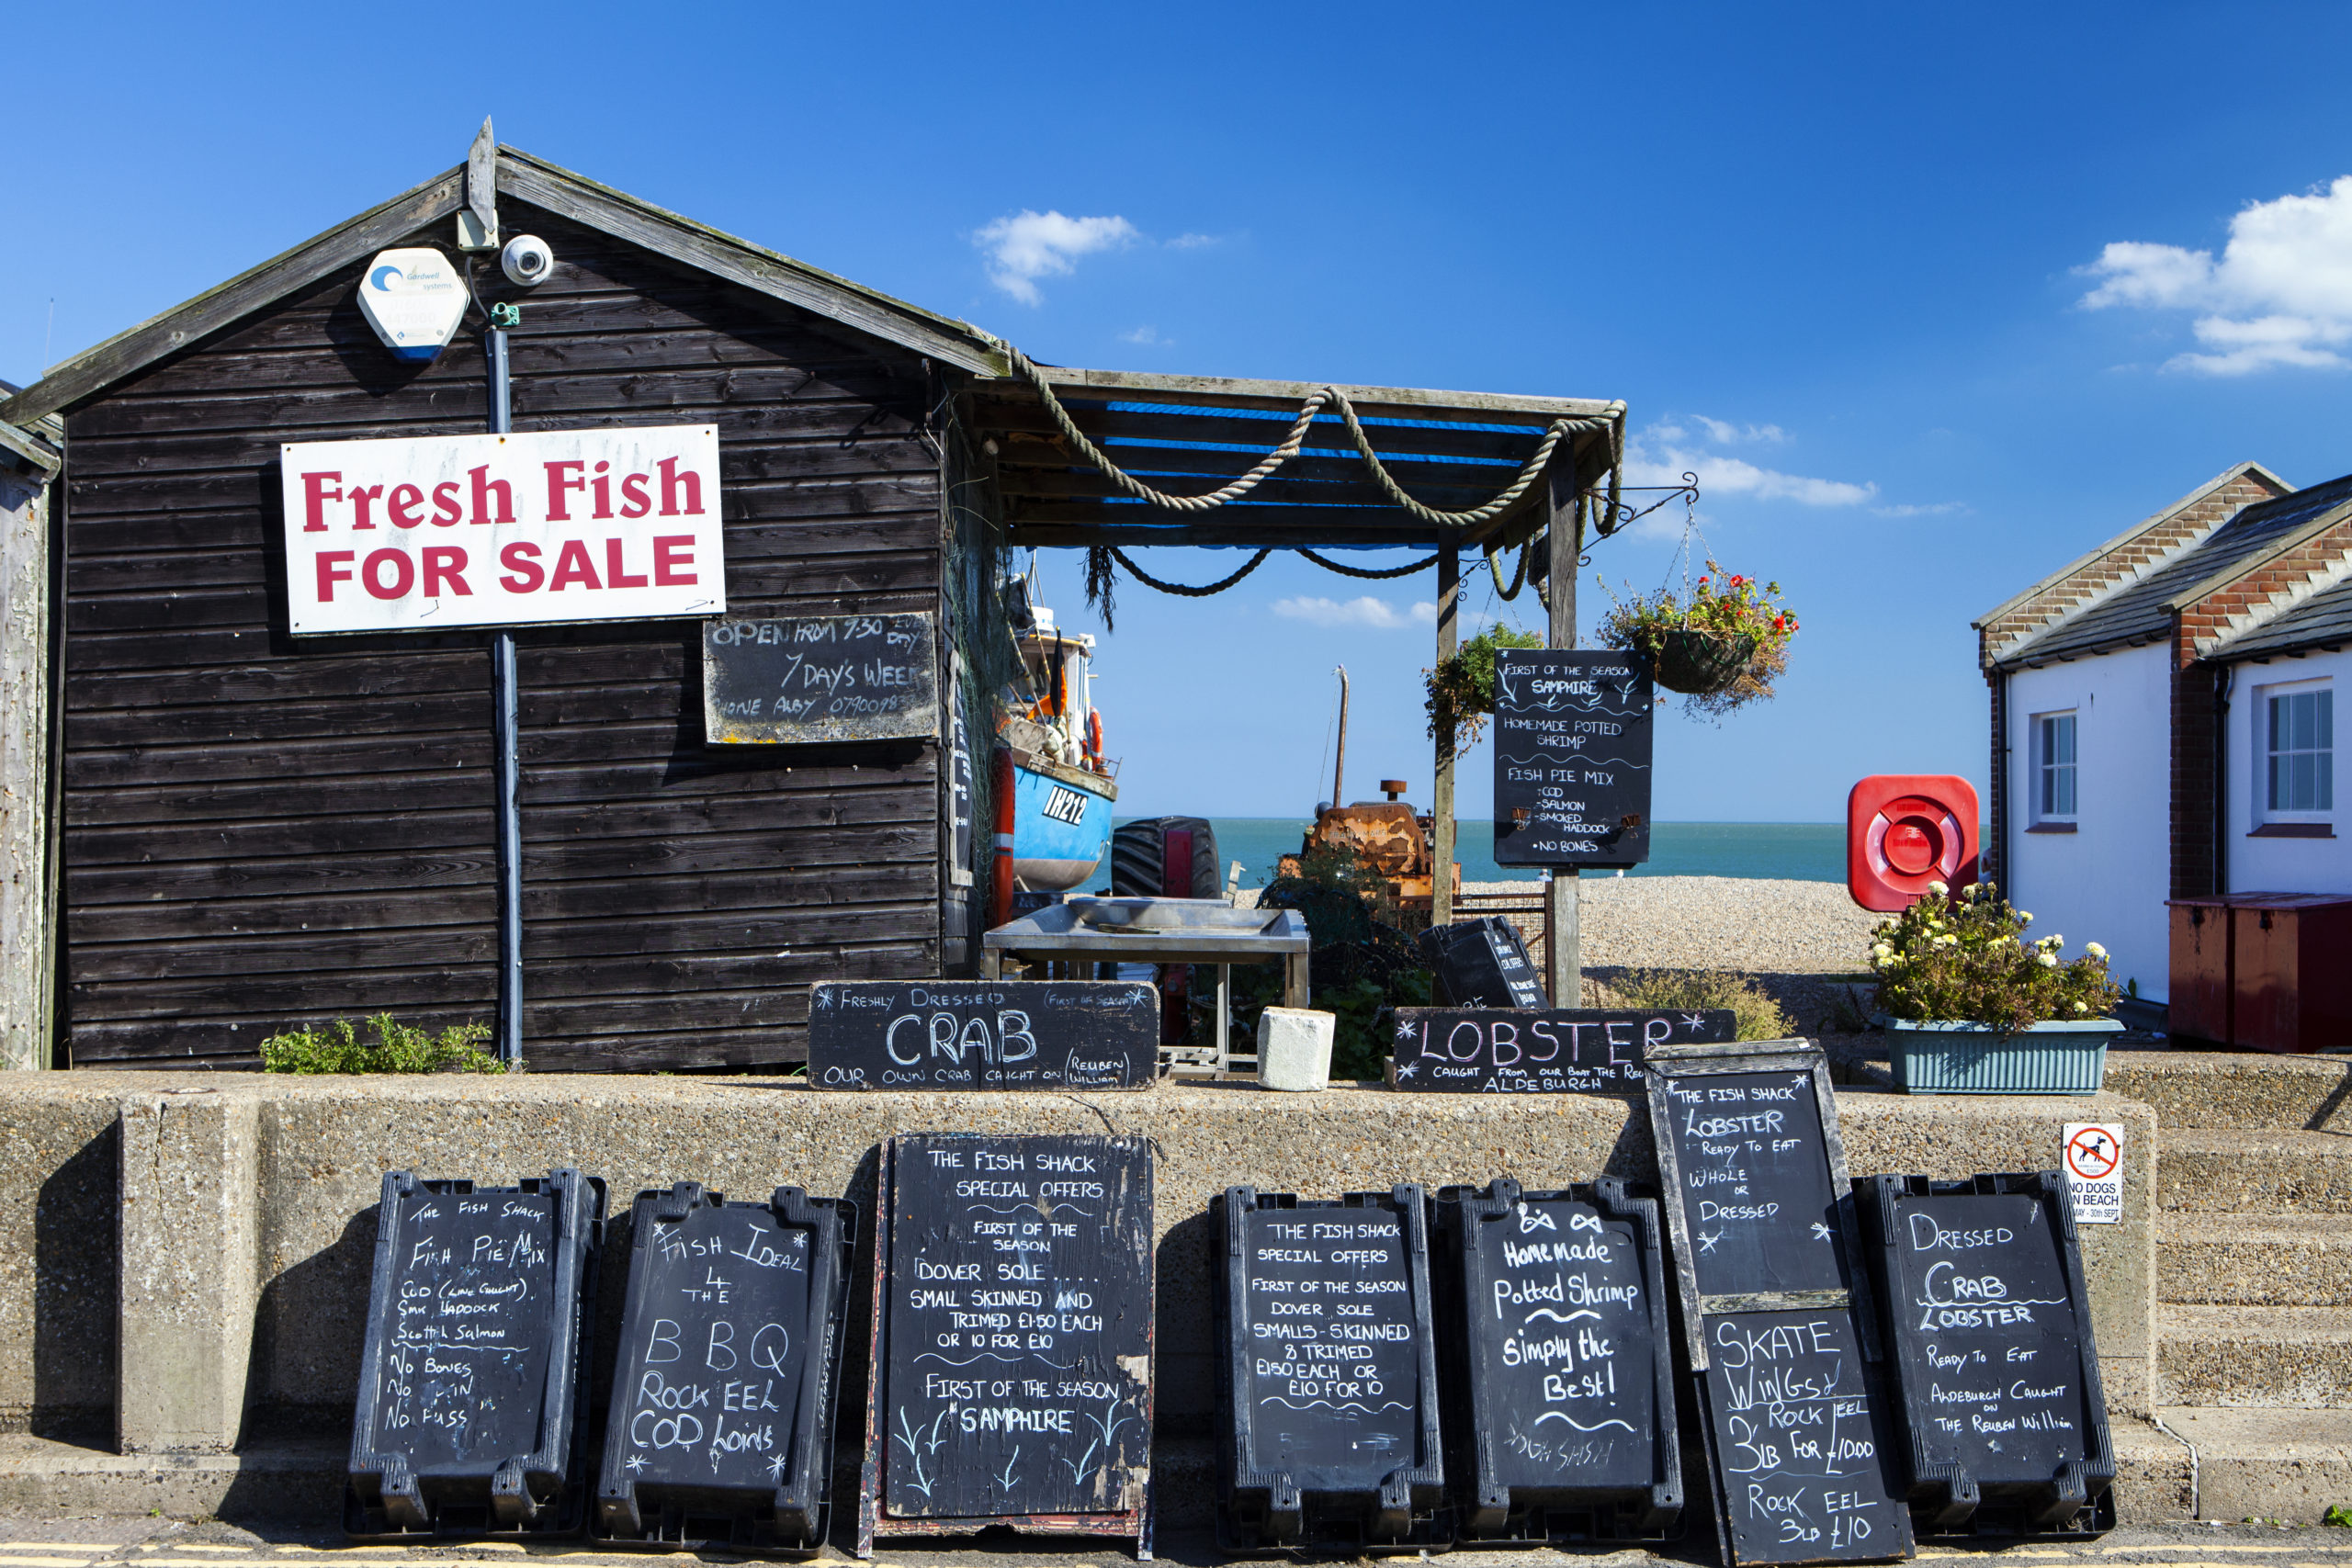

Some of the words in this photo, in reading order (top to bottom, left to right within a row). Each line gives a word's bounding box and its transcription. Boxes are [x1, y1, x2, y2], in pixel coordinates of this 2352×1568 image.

[407, 272, 440, 280] Gardwell
[300, 463, 516, 533] Fresh
[543, 455, 706, 522] Fish
[315, 545, 473, 603] FOR
[498, 535, 698, 593] SALE
[713, 623, 789, 646] OPEN
[794, 621, 835, 643] FROM
[781, 652, 803, 688] 7
[1504, 663, 1538, 676] FIRST
[1544, 664, 1557, 675] OF
[1564, 666, 1581, 676] THE
[1590, 665, 1633, 676] SEASON
[1531, 680, 1598, 695] SAMPHIRE
[774, 695, 816, 720] ALBY
[1504, 717, 1567, 733] HOMEMADE
[1575, 720, 1622, 736] POTTED
[1536, 735, 1587, 750] SHRIMP
[1508, 768, 1543, 781] FISH
[1551, 769, 1576, 782] PIE
[1585, 771, 1614, 785] MIX
[1043, 786, 1088, 825] IH212
[1563, 823, 1611, 835] HADDOCK
[1539, 840, 1557, 852] NO
[1560, 840, 1599, 852] BONES
[841, 989, 896, 1011] FRESHLY
[910, 987, 1005, 1007] DRESSED
[886, 1009, 1037, 1066] CRAB
[1420, 1017, 1672, 1066] LOBSTER
[824, 1066, 865, 1085] OUR
[882, 1069, 926, 1084] OWN
[934, 1068, 972, 1082] CRAB
[1042, 1070, 1061, 1079] ON
[1432, 1066, 1480, 1078] CAUGHT
[1498, 1067, 1528, 1078] FROM
[1539, 1066, 1562, 1077] OUR
[1567, 1066, 1590, 1077] BOAT
[1593, 1066, 1616, 1078] THE
[1482, 1077, 1602, 1093] ALDEBURGH
[1675, 1090, 1704, 1103] THE
[1709, 1088, 1746, 1102] FISH
[1751, 1088, 1797, 1101] SHACK
[1683, 1108, 1784, 1138] LOBSTER
[928, 1150, 965, 1168] THE
[975, 1151, 1024, 1172] FISH
[1036, 1154, 1097, 1173] SHACK
[1702, 1141, 1740, 1166] READY
[1746, 1140, 1762, 1152] TO
[1772, 1139, 1802, 1152] EAT
[1690, 1168, 1748, 1188] WHOLE
[2070, 1182, 2084, 1193] NO
[2086, 1182, 2117, 1194] DOGS
[956, 1180, 1030, 1198] SPECIAL
[1040, 1181, 1103, 1199] OFFERS
[1735, 1186, 1749, 1195] OR
[2083, 1194, 2119, 1206] BEACH
[410, 1202, 441, 1223] THE
[459, 1201, 489, 1213] FISH
[501, 1201, 545, 1223] SHACK
[1700, 1201, 1780, 1221] DRESSED
[2090, 1208, 2103, 1218] 30th
[2104, 1208, 2119, 1218] SEPT
[974, 1221, 1017, 1235] FIRST
[1023, 1223, 1045, 1235] OF
[1050, 1223, 1078, 1237] THE
[1267, 1224, 1307, 1240] THE
[1313, 1223, 1353, 1239] FISH
[1357, 1223, 1401, 1238] SHACK
[1909, 1213, 2013, 1251] DRESSED
[730, 1223, 803, 1272] IDEAL
[993, 1240, 1051, 1254] SEASON
[1257, 1249, 1322, 1264] SPECIAL
[1330, 1250, 1388, 1264] OFFERS
[707, 1267, 732, 1289] 4
[915, 1258, 982, 1281] DOVER
[401, 1280, 432, 1299] COD
[1252, 1278, 1295, 1292] FIRST
[1300, 1280, 1319, 1293] OF
[1324, 1280, 1350, 1294] THE
[1355, 1280, 1407, 1293] SEASON
[1925, 1261, 2007, 1308] CRAB
[682, 1288, 729, 1303] THE
[910, 1290, 960, 1309] SMALL
[971, 1290, 1042, 1309] SKINNED
[1055, 1292, 1093, 1310] AND
[1494, 1273, 1564, 1320] Potted
[1568, 1272, 1639, 1311] Shrimp
[441, 1301, 500, 1316] HADDOCK
[1272, 1303, 1323, 1315] DOVER
[1337, 1303, 1374, 1316] SOLE
[1920, 1305, 2036, 1331] LOBSTER
[949, 1312, 1012, 1330] TRIMED
[1062, 1314, 1103, 1332] EACH
[1329, 1323, 1410, 1341] SKINNED
[937, 1333, 960, 1347] OR
[971, 1334, 985, 1348] 10
[991, 1334, 1022, 1348] FOR
[1502, 1329, 1574, 1373] Simply
[1578, 1327, 1614, 1361] the
[1717, 1322, 1841, 1368] SKATE
[1302, 1344, 1374, 1360] TRIMED
[1927, 1345, 1967, 1374] READY
[1973, 1350, 1986, 1364] TO
[2007, 1347, 2038, 1362] EAT
[1296, 1363, 1340, 1382] EACH
[1354, 1364, 1378, 1380] OR
[637, 1370, 710, 1409] ROCK
[724, 1378, 780, 1413] EEL
[925, 1373, 988, 1399] FIRST
[991, 1381, 1016, 1397] OF
[1022, 1380, 1051, 1398] THE
[1057, 1381, 1119, 1400] SEASON
[1324, 1381, 1363, 1398] FOR
[1367, 1381, 1384, 1395] 10
[1931, 1382, 2002, 1404] ALDEBURGH
[2009, 1380, 2067, 1400] CAUGHT
[1770, 1401, 1824, 1429] ROCK
[1836, 1400, 1869, 1417] EEL
[1984, 1404, 1998, 1413] ON
[631, 1410, 704, 1449] COD
[960, 1406, 1076, 1434] SAMPHIRE
[1935, 1417, 1962, 1433] THE
[1972, 1415, 2016, 1434] REUBEN
[1790, 1430, 1822, 1459] FOR
[1748, 1483, 1807, 1521] ROCK
[1824, 1491, 1878, 1514] EEL
[1831, 1516, 1872, 1550] £10
